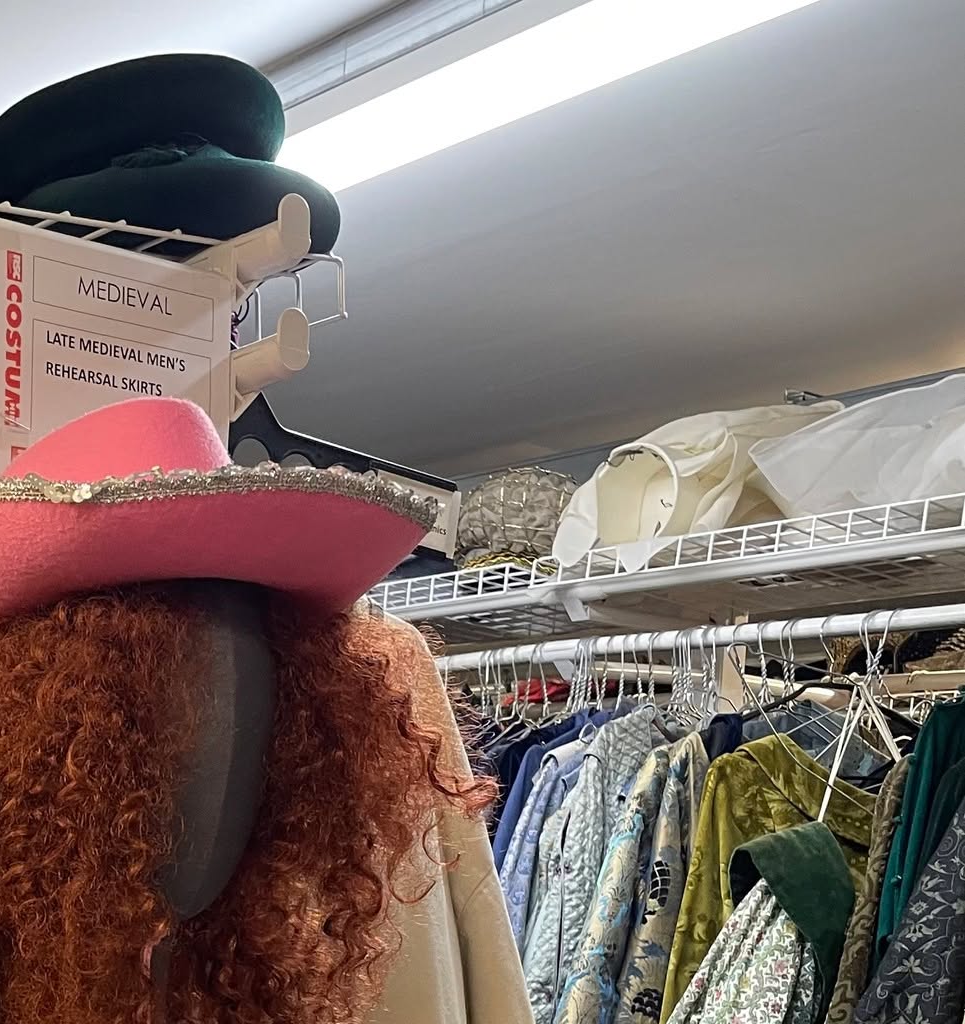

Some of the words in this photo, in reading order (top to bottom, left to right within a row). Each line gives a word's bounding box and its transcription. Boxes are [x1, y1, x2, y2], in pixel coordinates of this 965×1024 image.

[77, 276, 173, 316] MEDIEVAL
[46, 330, 75, 349] LATE
[79, 337, 144, 364] MEDIEVAL
[147, 351, 186, 373] MEN'S
[46, 361, 118, 389] REHEARSAL
[121, 376, 162, 397] SKIRTS
